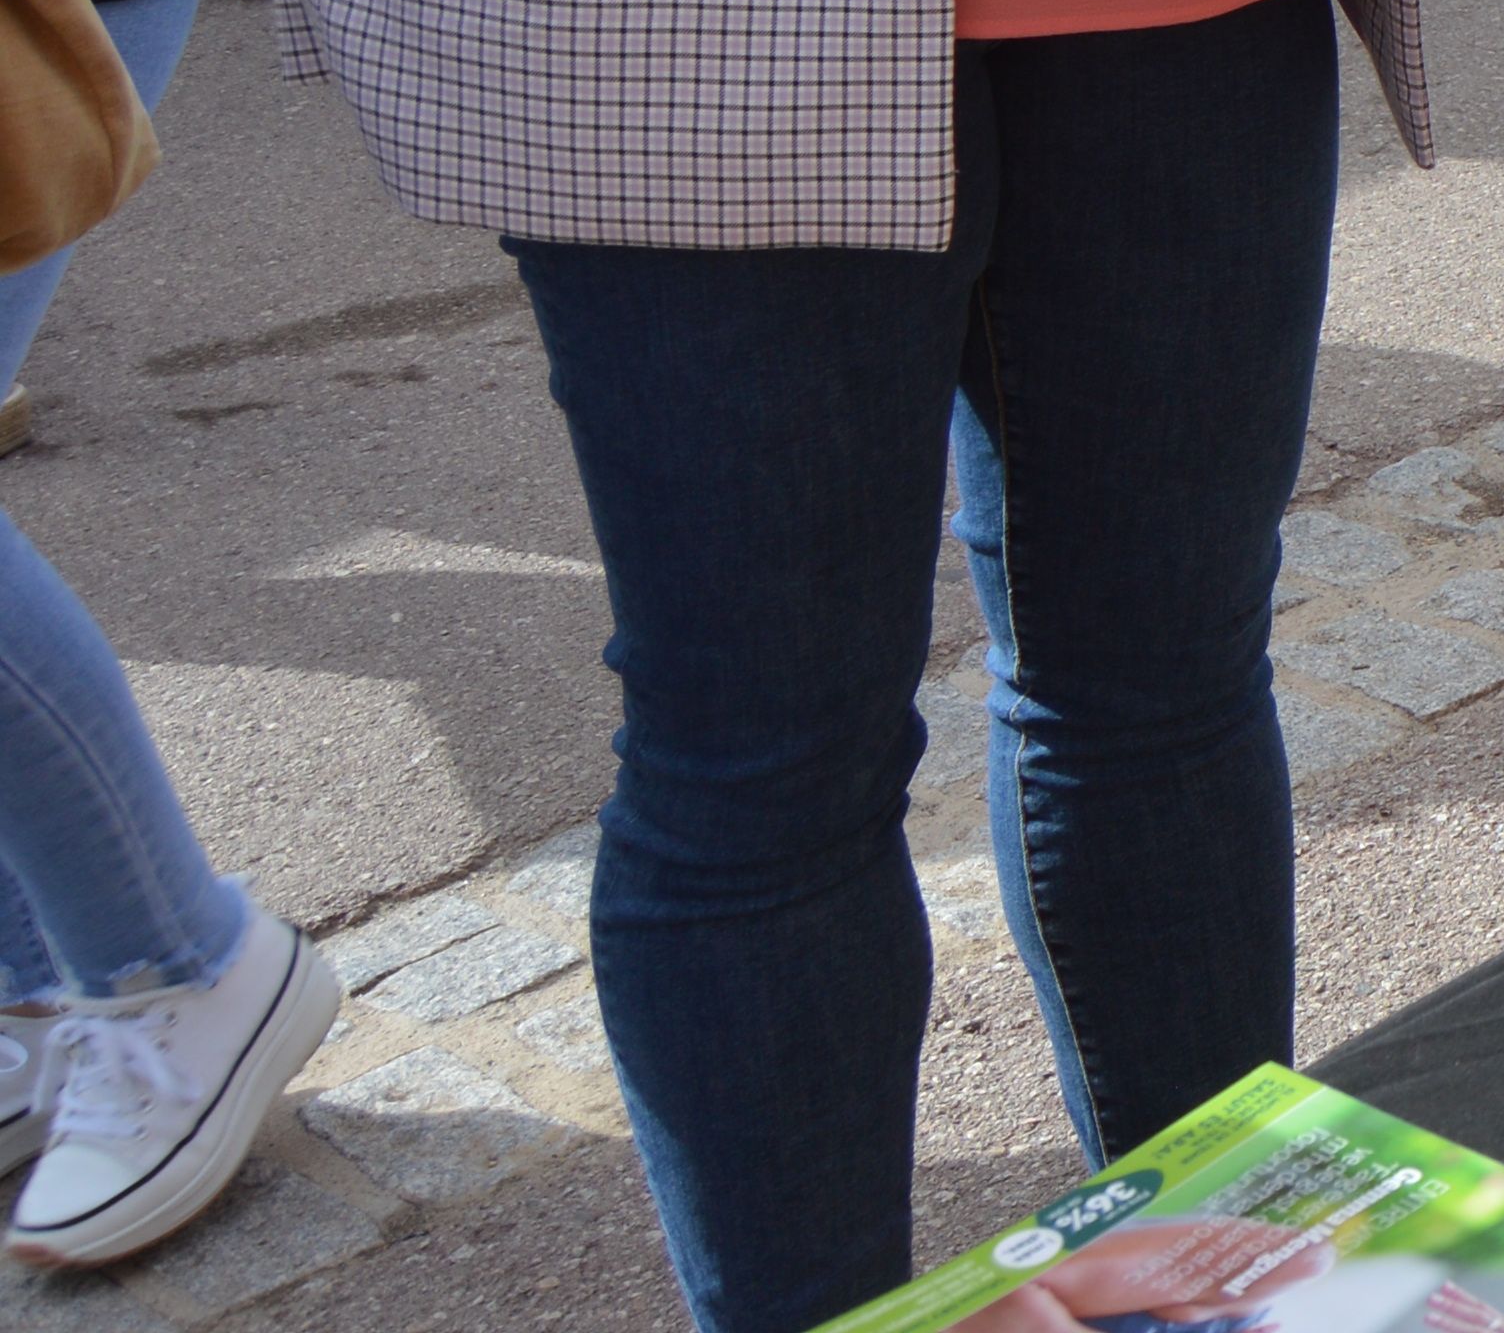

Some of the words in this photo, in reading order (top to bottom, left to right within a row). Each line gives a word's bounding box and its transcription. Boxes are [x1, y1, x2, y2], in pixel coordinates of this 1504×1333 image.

[1055, 1184, 1137, 1236] 36%
[1327, 1167, 1422, 1227] Gemma
[1221, 1221, 1334, 1296] Mengual
